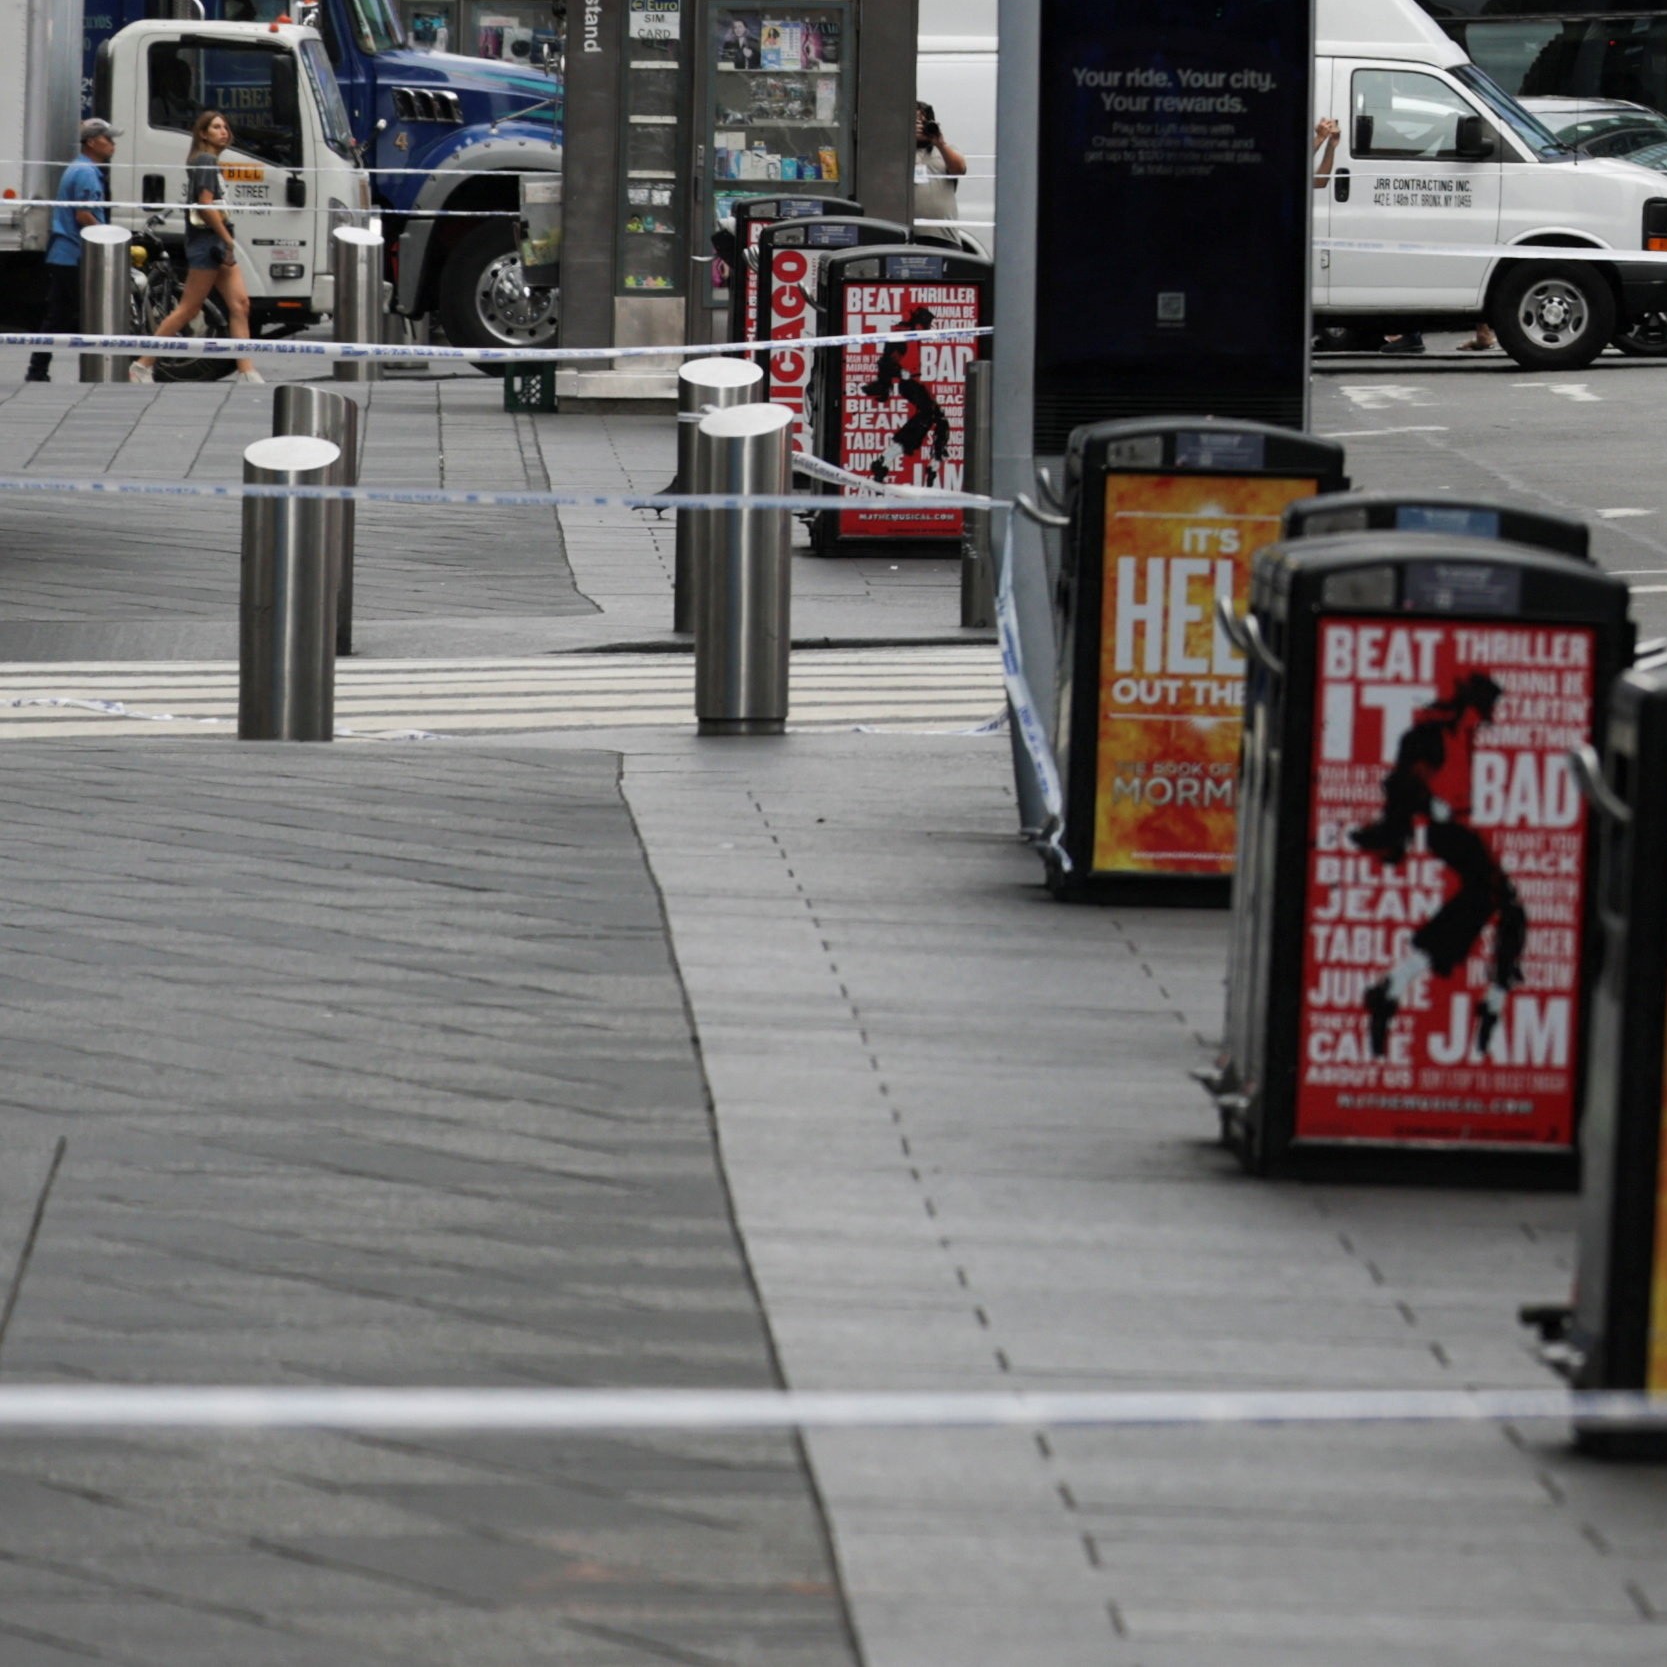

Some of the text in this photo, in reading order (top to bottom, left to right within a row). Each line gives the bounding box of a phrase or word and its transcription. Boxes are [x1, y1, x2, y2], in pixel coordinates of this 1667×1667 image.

[644, 14, 665, 23] SIM
[647, 0, 678, 12] Euro
[1073, 69, 1277, 93] Your ride. Your city.
[1102, 93, 1248, 113] Your rewards.
[228, 168, 260, 180] BILL
[1374, 179, 1472, 192] JRR CONTRACTING INC.
[234, 185, 269, 198] STREET
[1444, 195, 1452, 207] NY
[847, 287, 976, 313] BEAT THRILLER
[846, 315, 903, 354] IT
[964, 307, 975, 319] BE
[920, 346, 967, 383] BAD
[846, 399, 909, 414] BILLIE
[845, 414, 909, 430] JEAN
[1182, 527, 1241, 554] IT'S
[1113, 555, 1247, 675] HEL
[1323, 626, 1590, 682] BEAT THRILLER
[1111, 678, 1184, 705] OUT
[1321, 683, 1438, 763] IT
[1111, 776, 1234, 808] MORM
[1470, 752, 1582, 827] BAD
[1316, 857, 1446, 888] BILLIE
[1314, 889, 1444, 922] JEAN
[1427, 994, 1572, 1067] JAM
